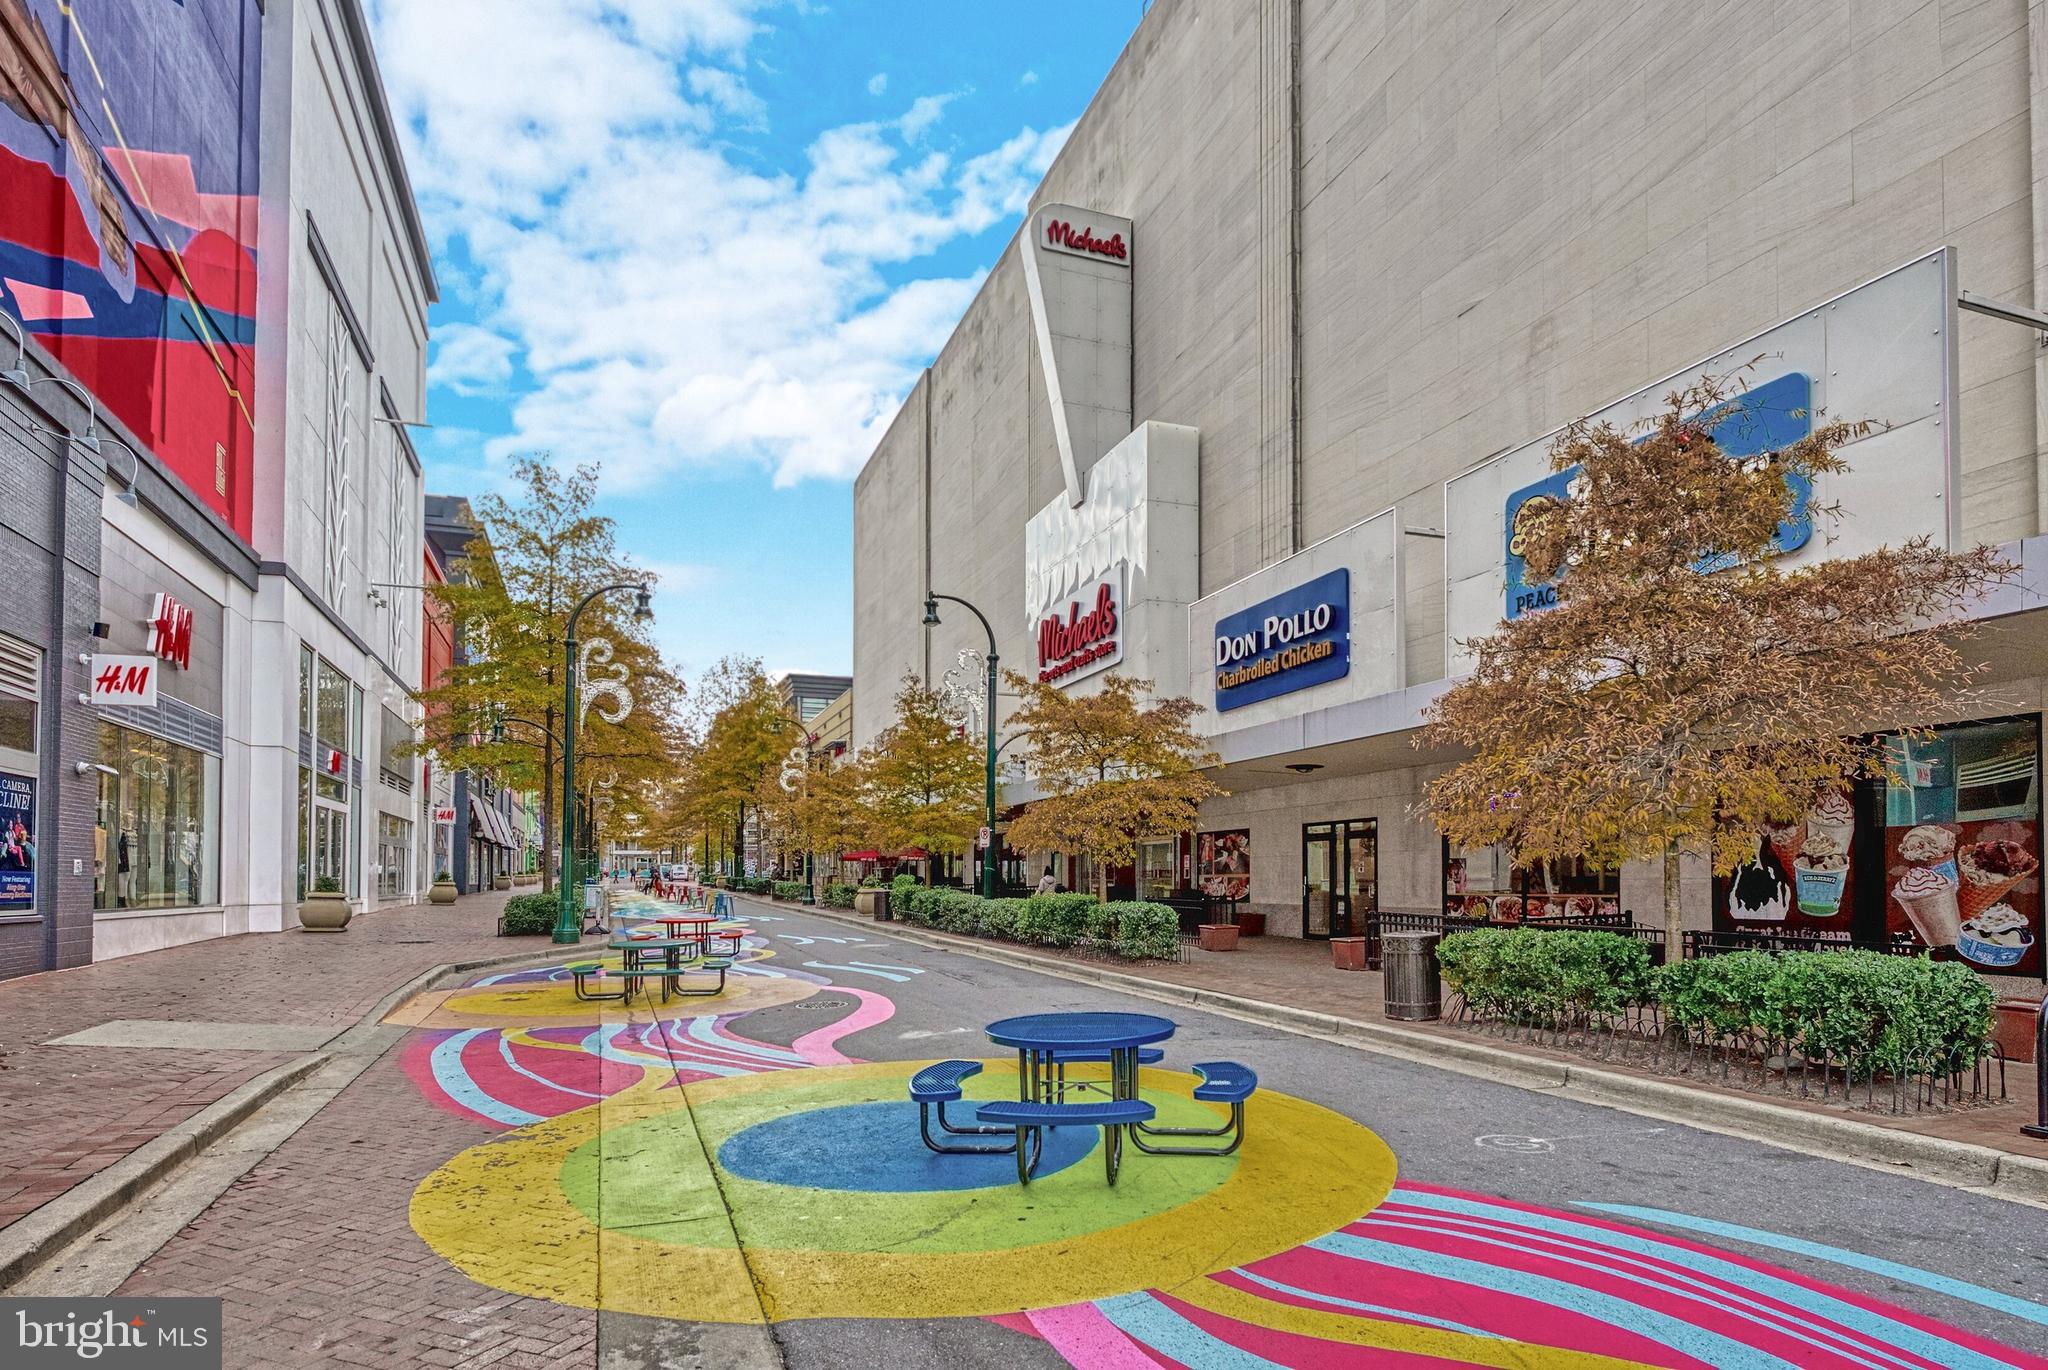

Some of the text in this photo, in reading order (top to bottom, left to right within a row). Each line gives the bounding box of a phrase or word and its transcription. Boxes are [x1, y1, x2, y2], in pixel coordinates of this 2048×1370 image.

[1048, 219, 1127, 259] Michaels
[155, 592, 193, 671] H&M
[1038, 583, 1117, 668] Michaels
[1216, 603, 1332, 666] DON POLLO
[96, 665, 150, 696] H&M
[1217, 641, 1333, 690] Charbroiled Chicken
[1736, 925, 1774, 936] Gat
